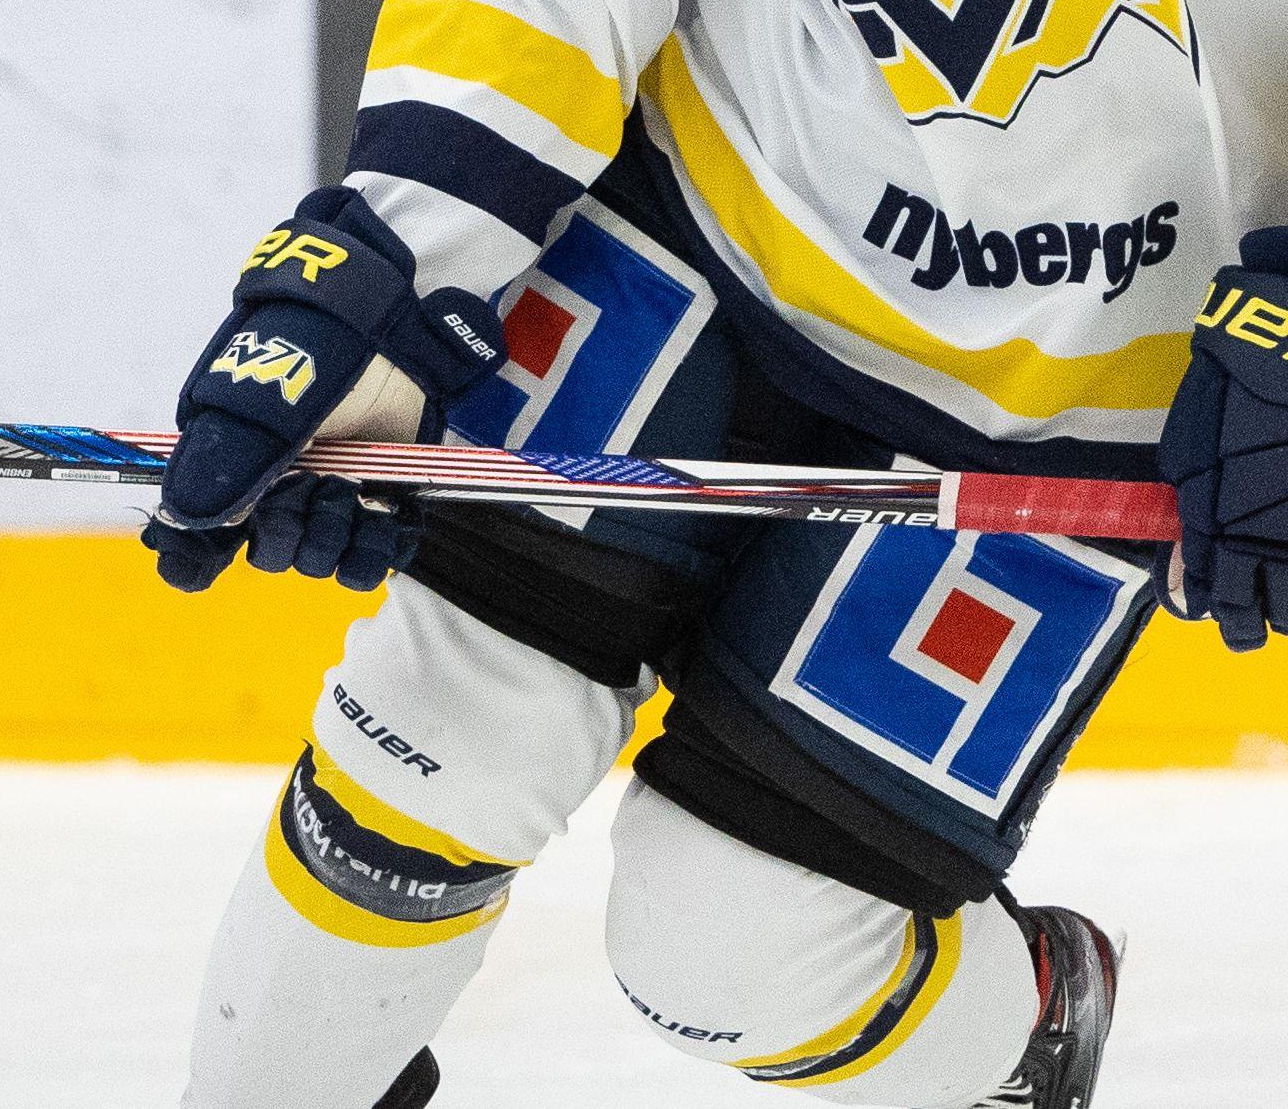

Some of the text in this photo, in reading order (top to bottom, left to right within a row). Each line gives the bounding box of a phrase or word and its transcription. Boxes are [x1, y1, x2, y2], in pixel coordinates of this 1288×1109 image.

[862, 181, 1180, 304] nybergs
[443, 312, 498, 362] BAUER
[806, 505, 941, 528] AUER
[333, 683, 443, 778] BAUER
[613, 973, 744, 1044] AUER
